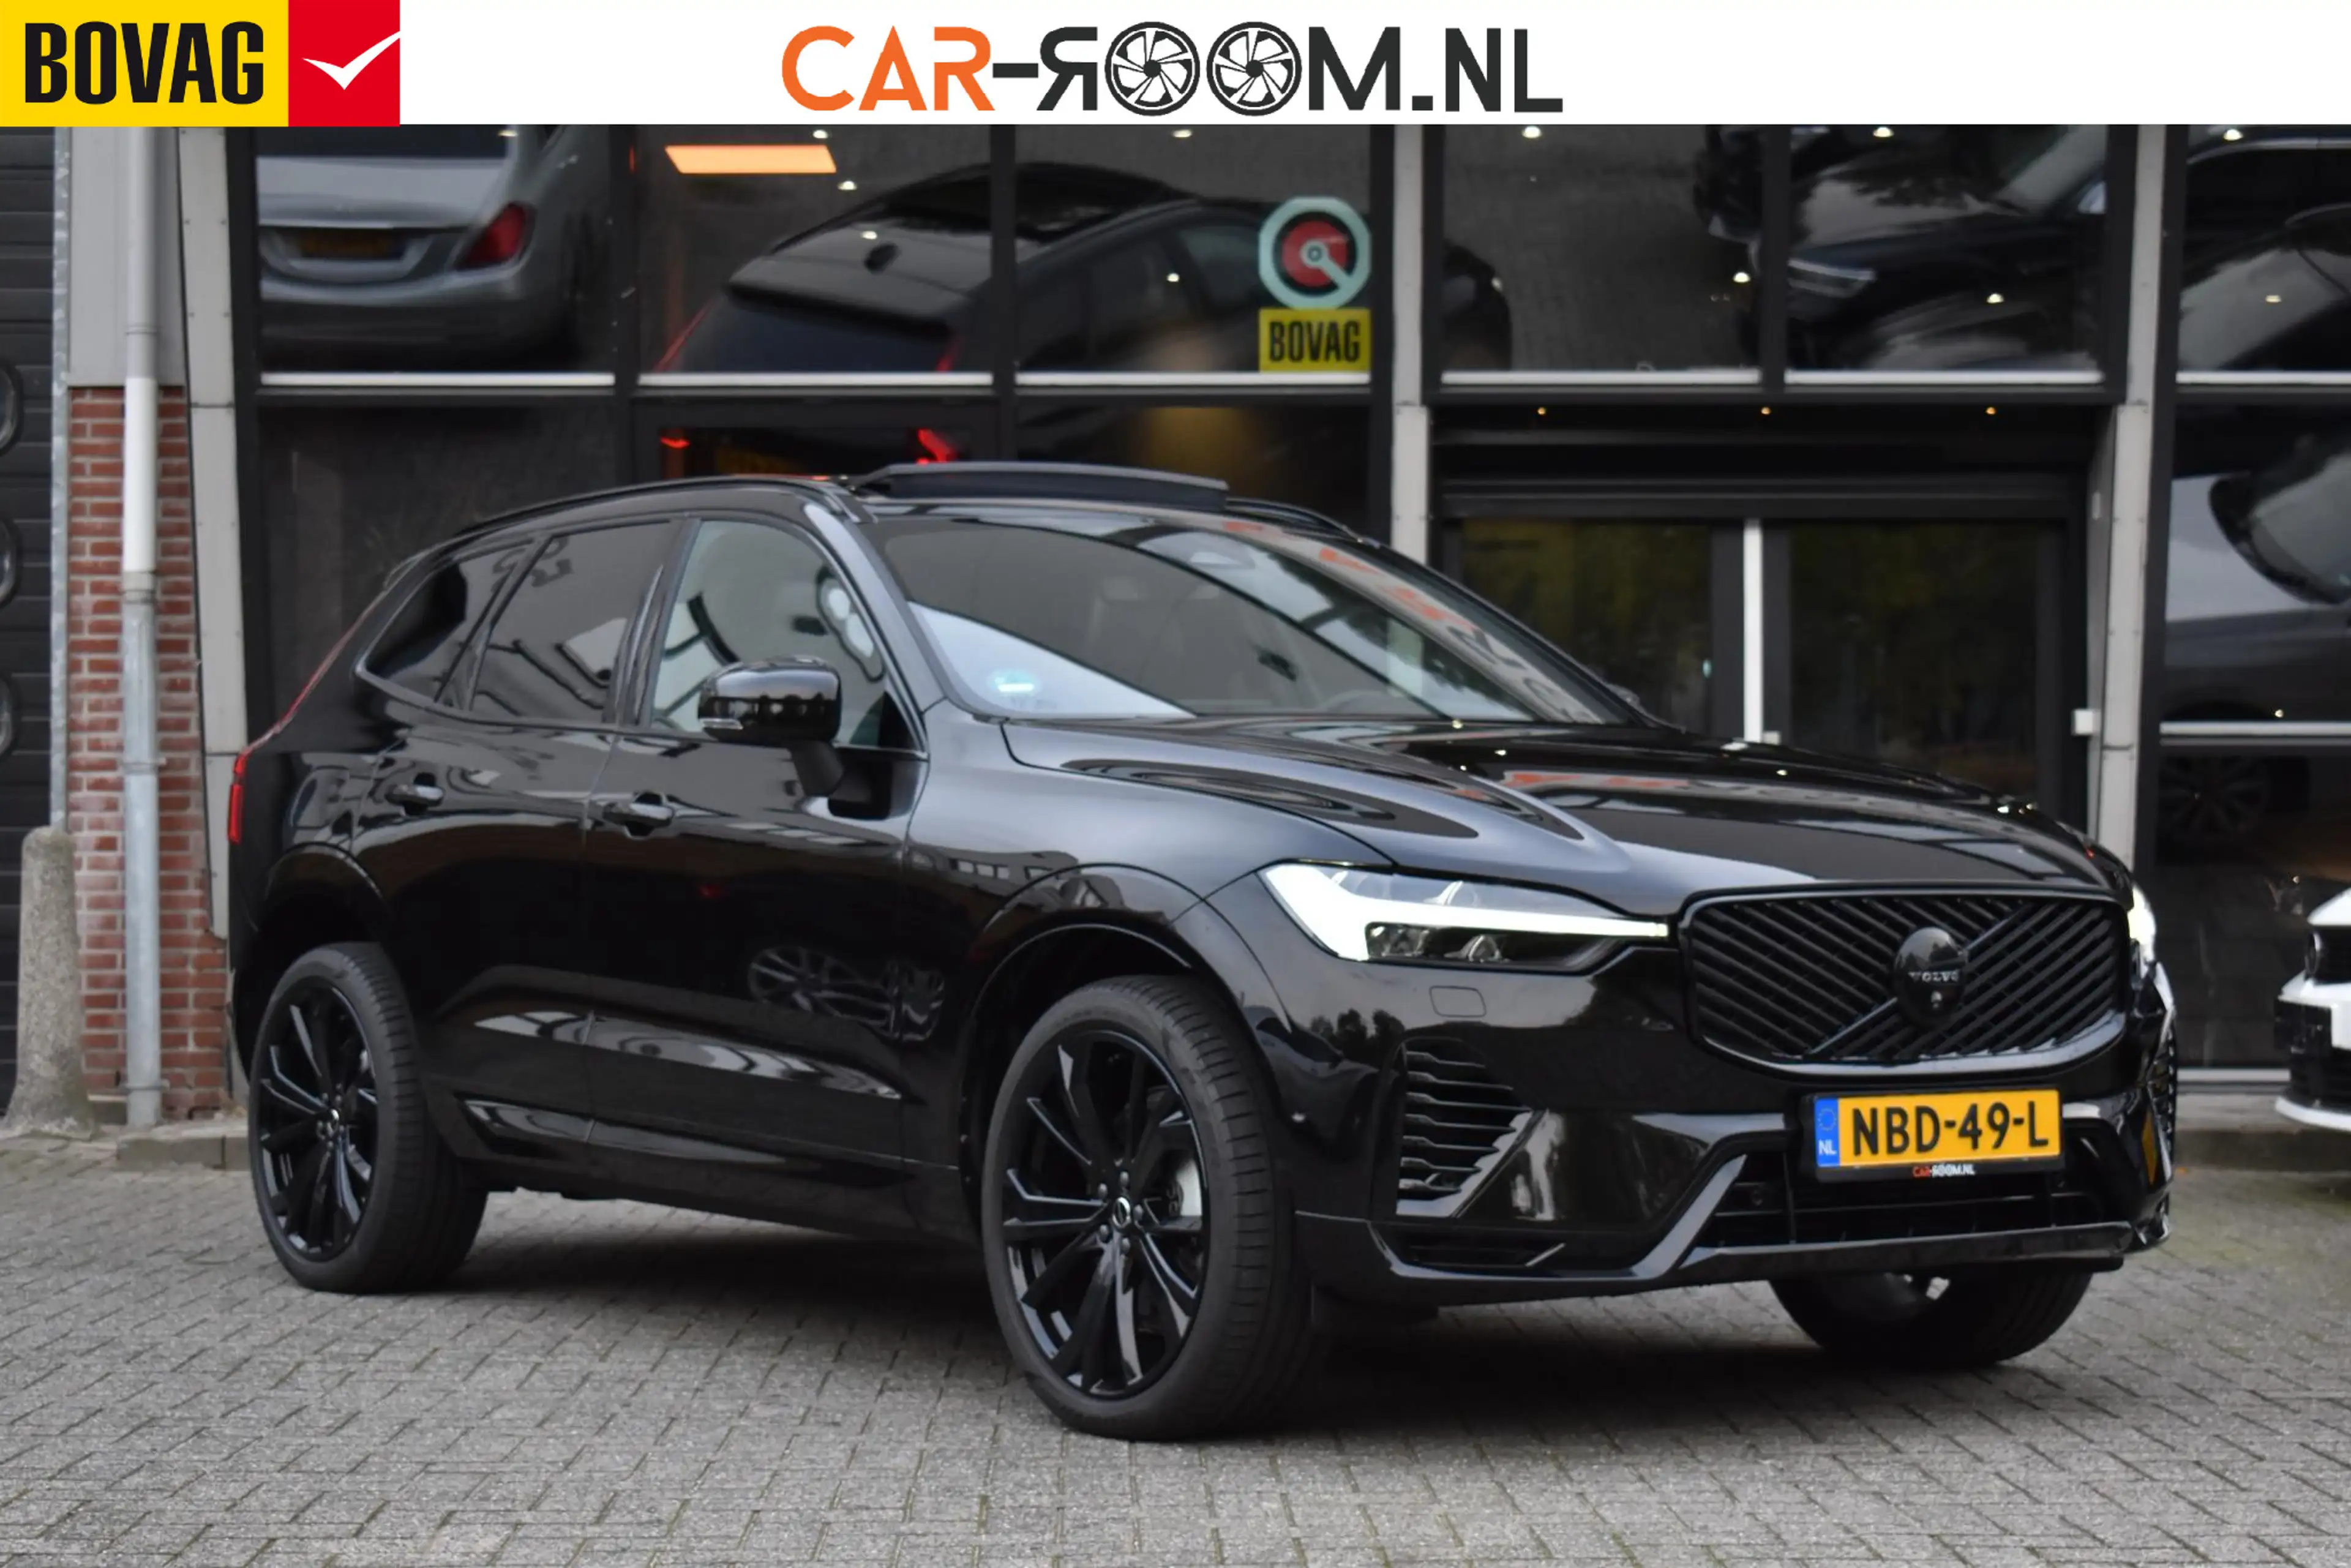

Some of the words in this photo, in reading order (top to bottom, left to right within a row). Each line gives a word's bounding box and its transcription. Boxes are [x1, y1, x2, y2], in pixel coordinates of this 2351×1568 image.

[1269, 321, 1360, 363] BOVAG
[1818, 1139, 1837, 1155] NL
[1853, 1101, 2049, 1156] NBD-49-L
